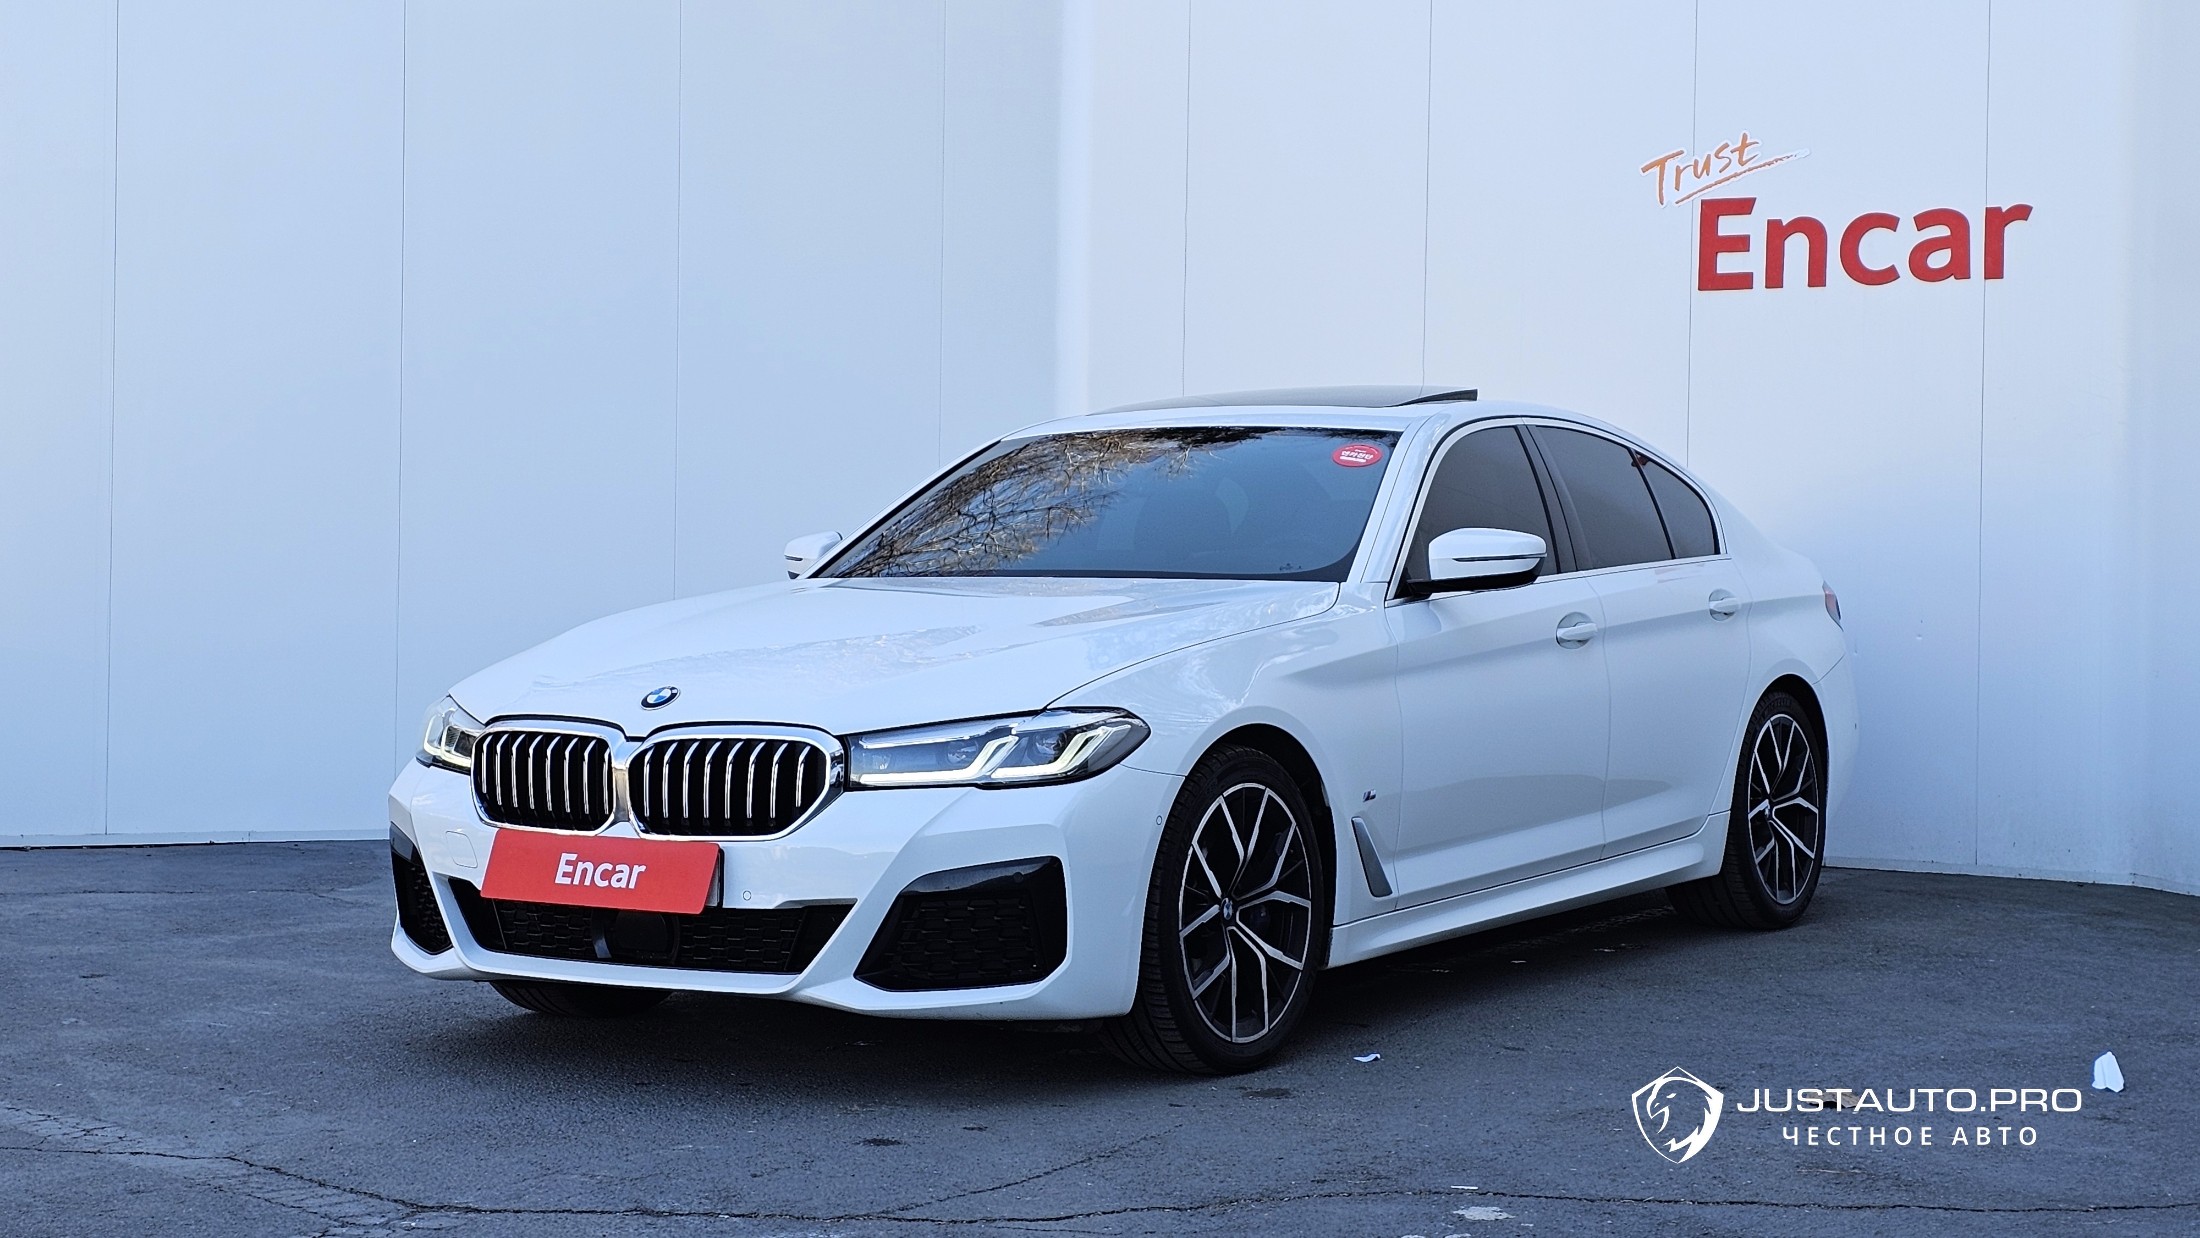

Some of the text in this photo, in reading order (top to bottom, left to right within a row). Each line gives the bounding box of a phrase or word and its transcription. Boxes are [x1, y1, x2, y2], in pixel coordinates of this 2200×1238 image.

[1641, 132, 1759, 206] Trust
[1697, 197, 2033, 291] Encar
[554, 852, 647, 889] Encar
